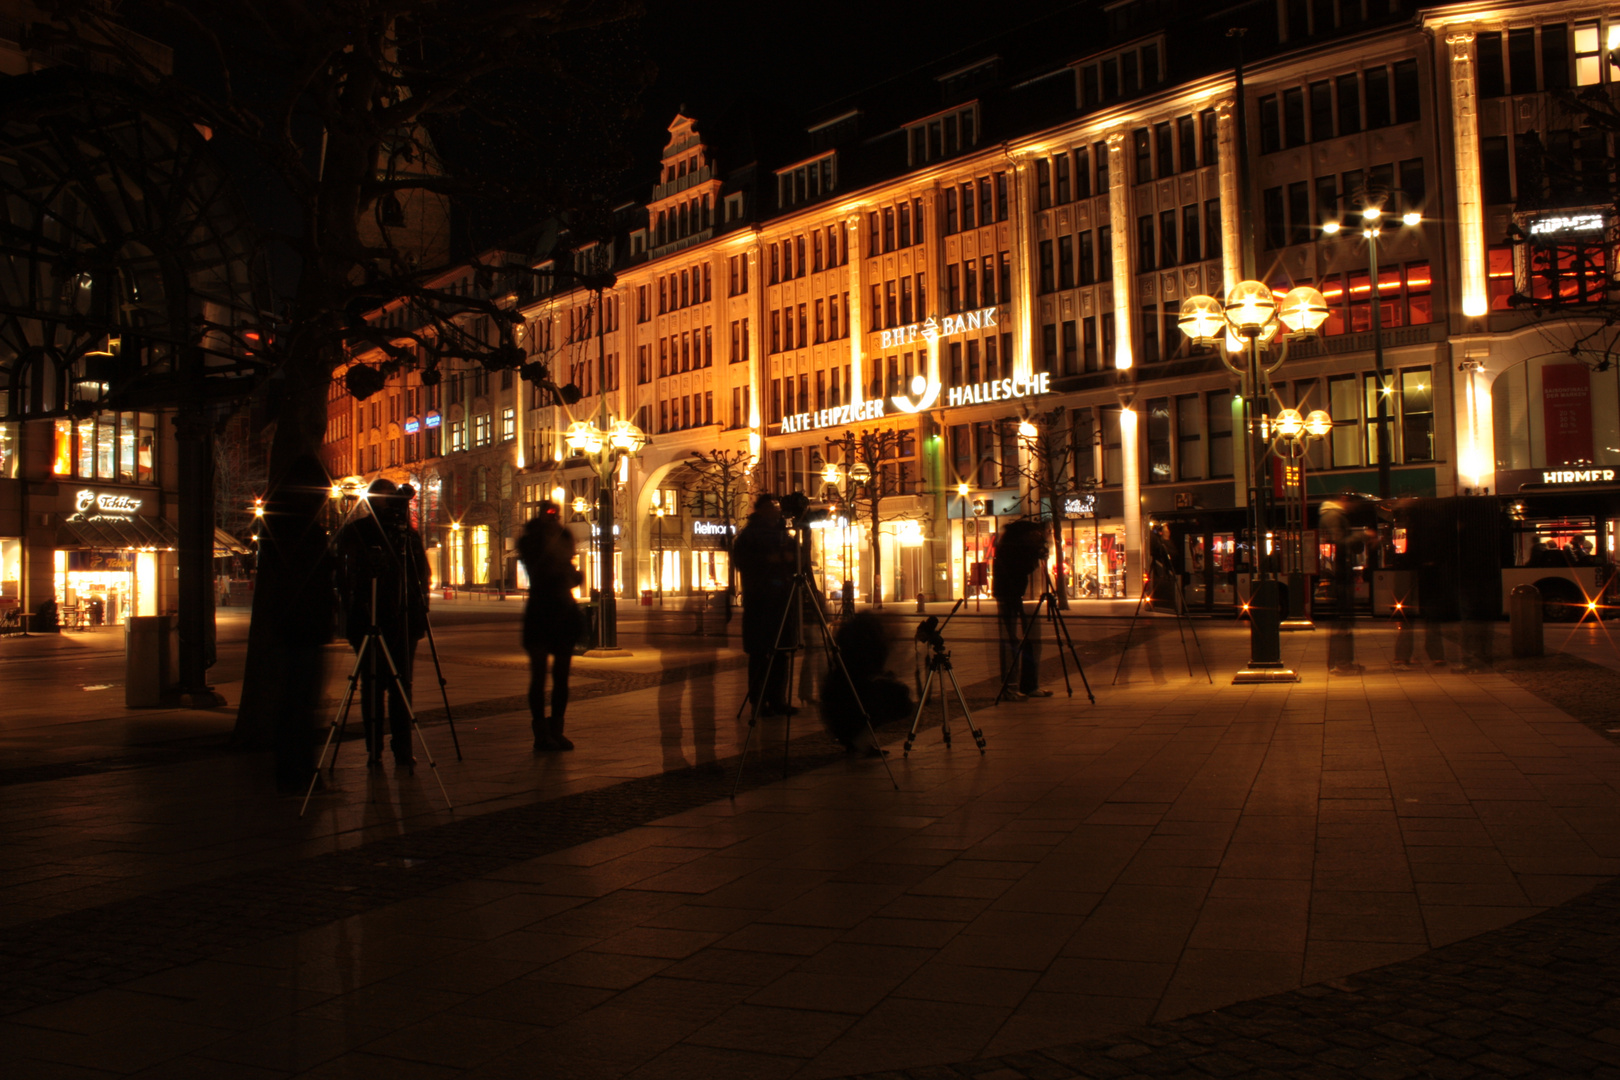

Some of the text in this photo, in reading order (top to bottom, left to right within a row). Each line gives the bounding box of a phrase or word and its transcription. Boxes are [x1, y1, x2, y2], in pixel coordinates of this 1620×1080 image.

[880, 307, 997, 349] BHF BANK
[949, 372, 1050, 407] HALLESCHE
[780, 398, 885, 434] ALTE LEIPZIGER
[1543, 469, 1615, 483] HIRMER
[98, 495, 141, 510] Tchibo
